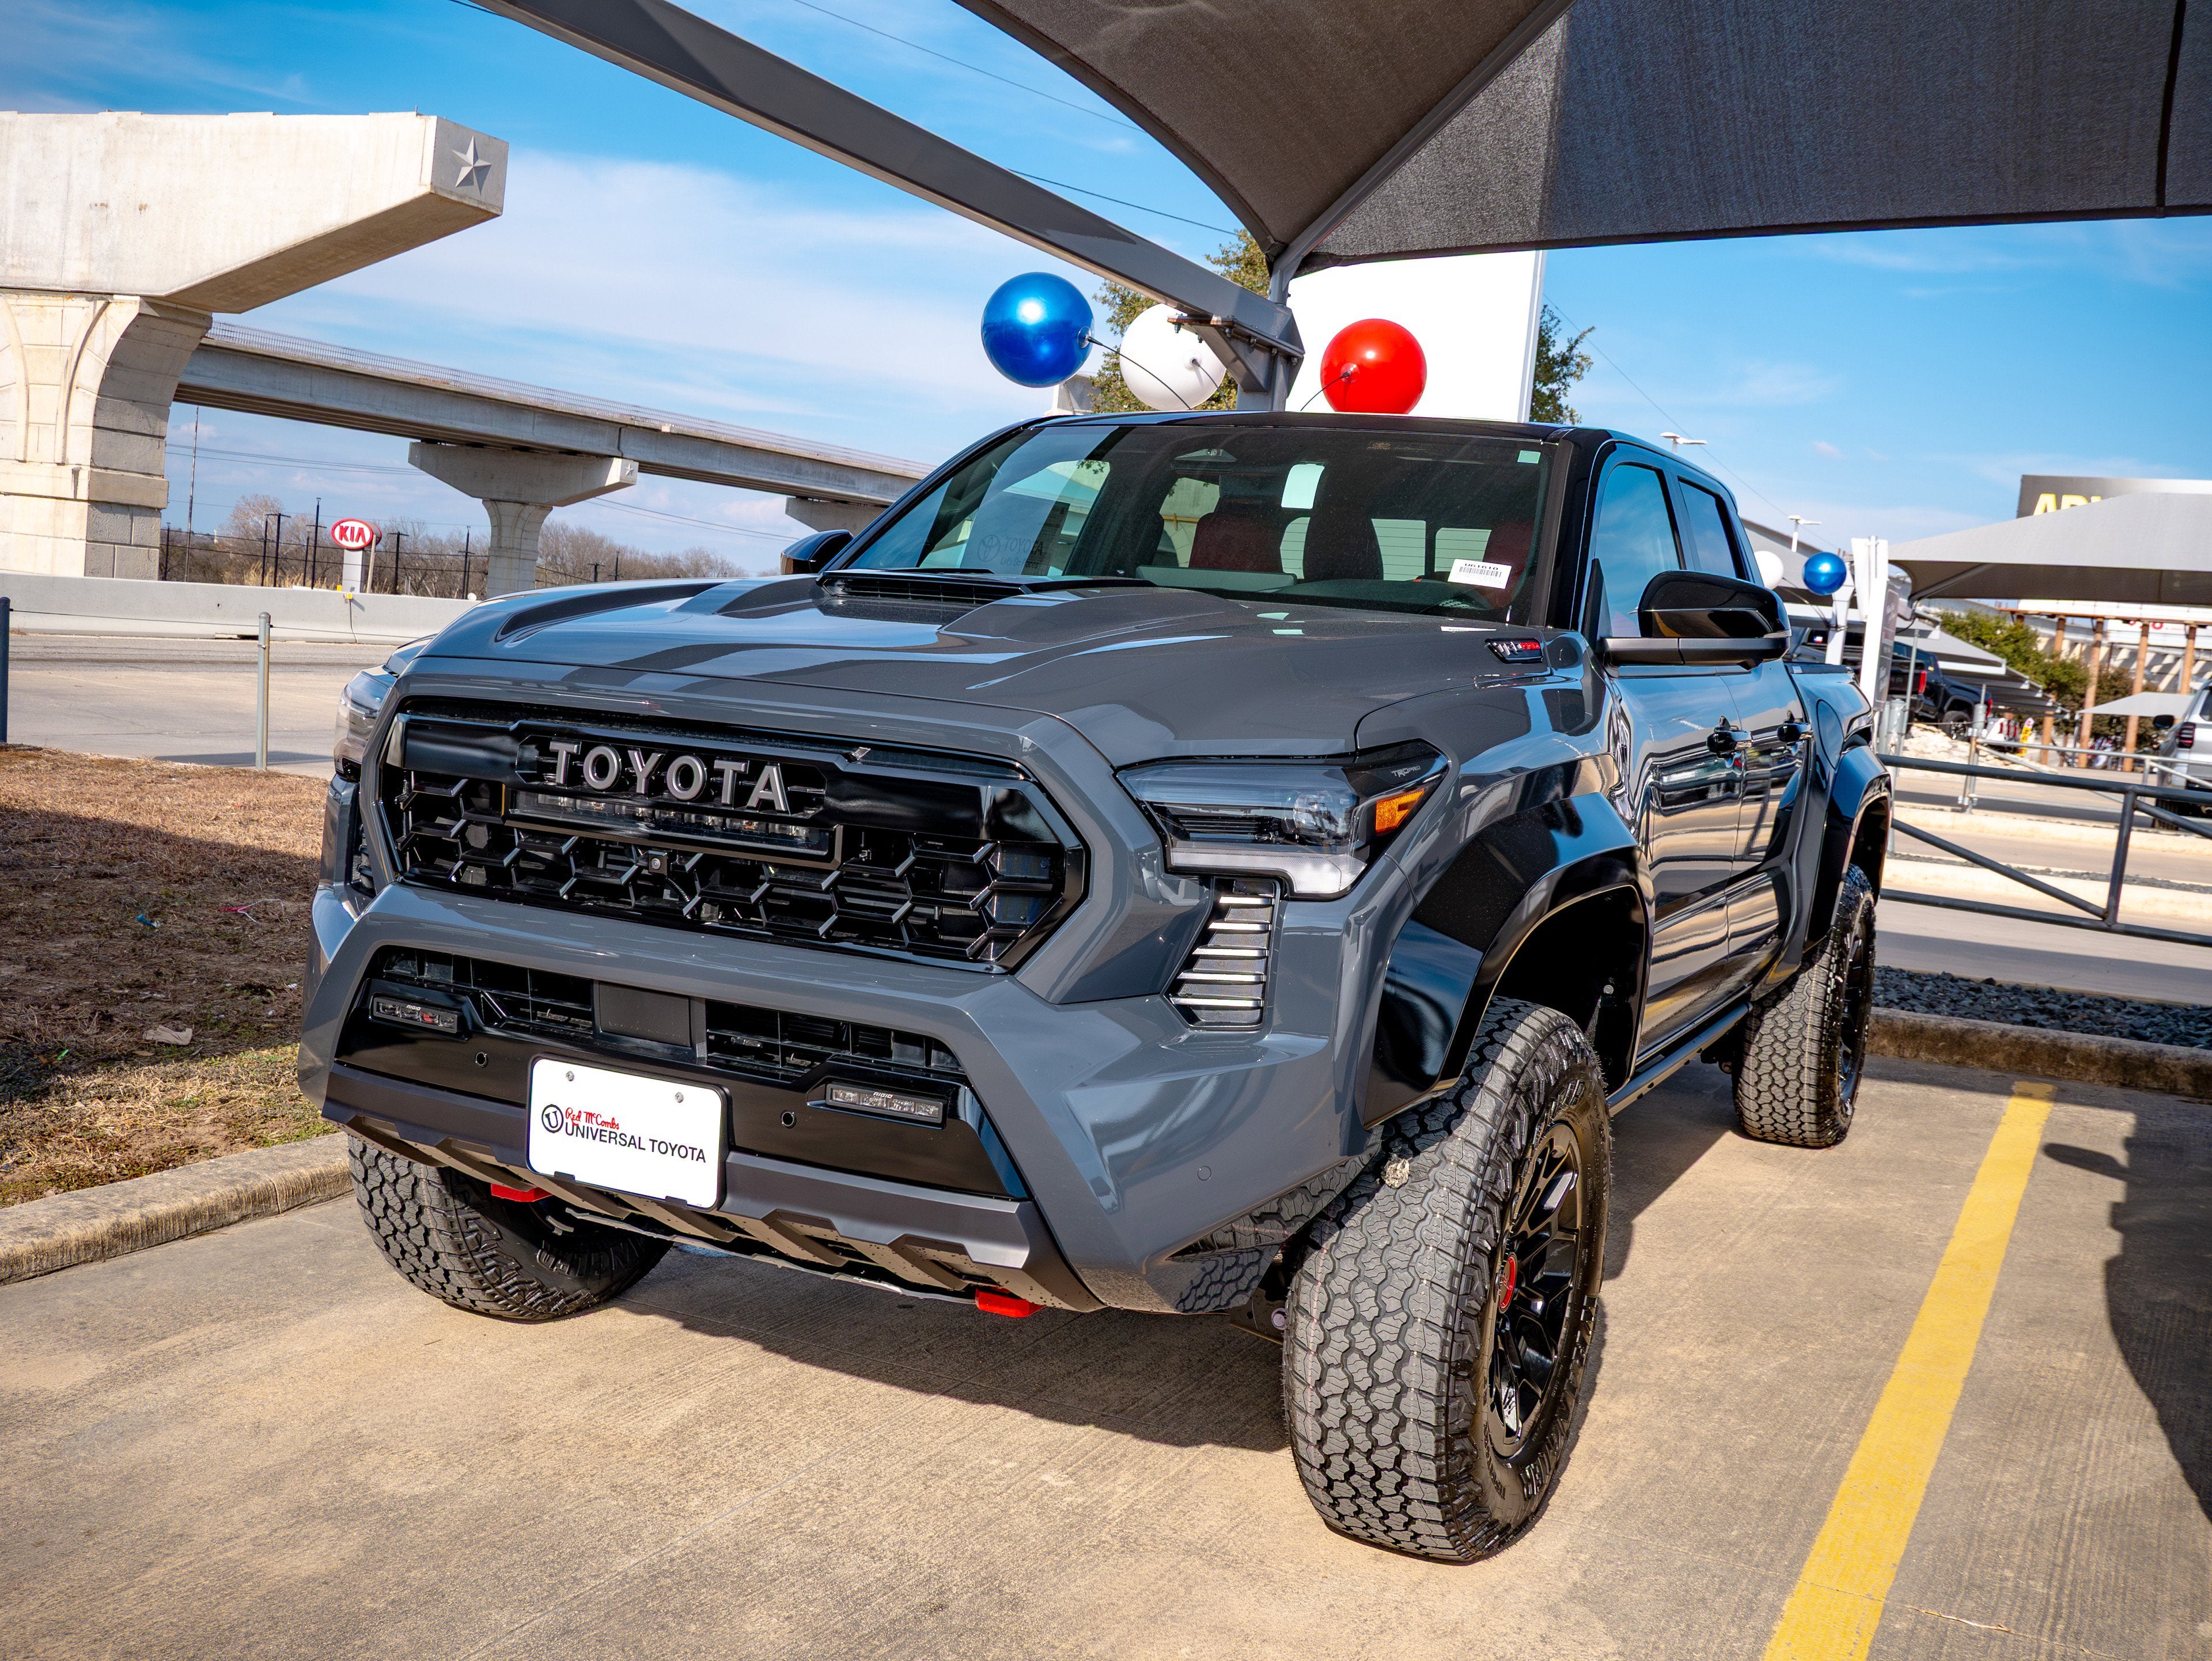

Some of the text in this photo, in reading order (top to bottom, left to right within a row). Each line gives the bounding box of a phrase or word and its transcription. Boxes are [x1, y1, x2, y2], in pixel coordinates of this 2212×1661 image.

[339, 525, 366, 543] KIA
[550, 740, 790, 815] TOYOTA
[1391, 768, 1409, 777] TRD
[566, 1107, 619, 1130] Red McCombs
[565, 1122, 706, 1163] UNIVERSAL TOYOTA
